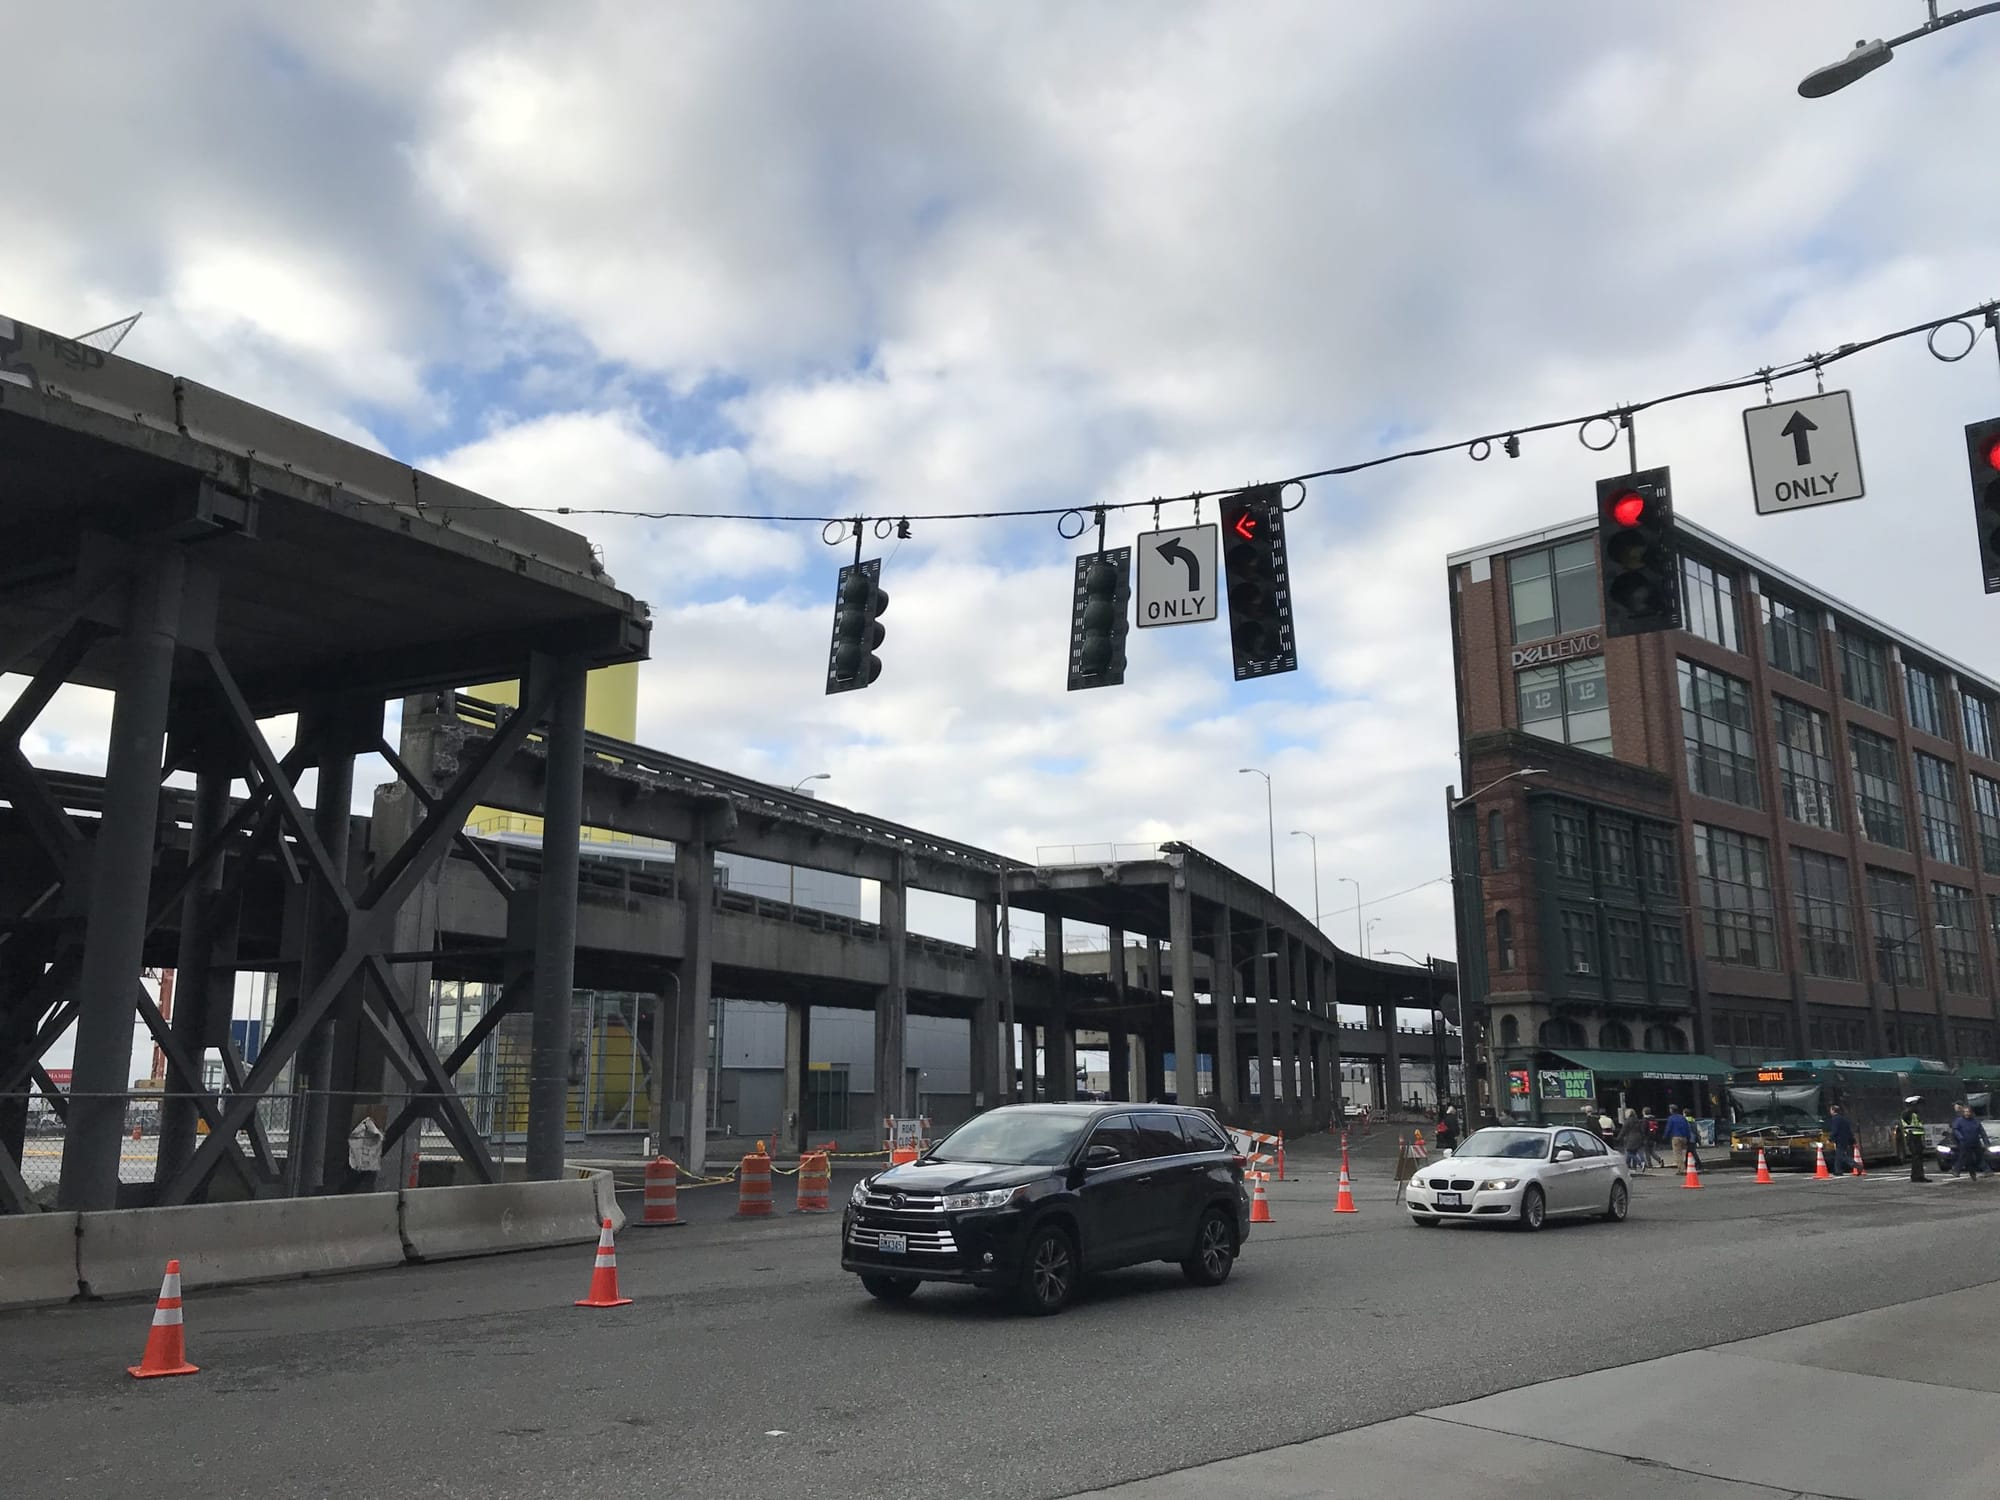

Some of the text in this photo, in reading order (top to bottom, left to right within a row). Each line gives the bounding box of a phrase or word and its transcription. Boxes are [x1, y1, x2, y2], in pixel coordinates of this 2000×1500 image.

[1775, 472, 1839, 502] ONLY
[1148, 596, 1206, 620] ONLY
[1511, 633, 1600, 667] DELL EMC
[1579, 682, 1596, 700] 12
[1535, 692, 1552, 709] 12
[1559, 1071, 1591, 1080] GAME
[1758, 1072, 1784, 1081] SHUTTLE
[1565, 1080, 1586, 1089] DAY
[1565, 1089, 1588, 1098] BBQ
[901, 1124, 916, 1133] ROAD
